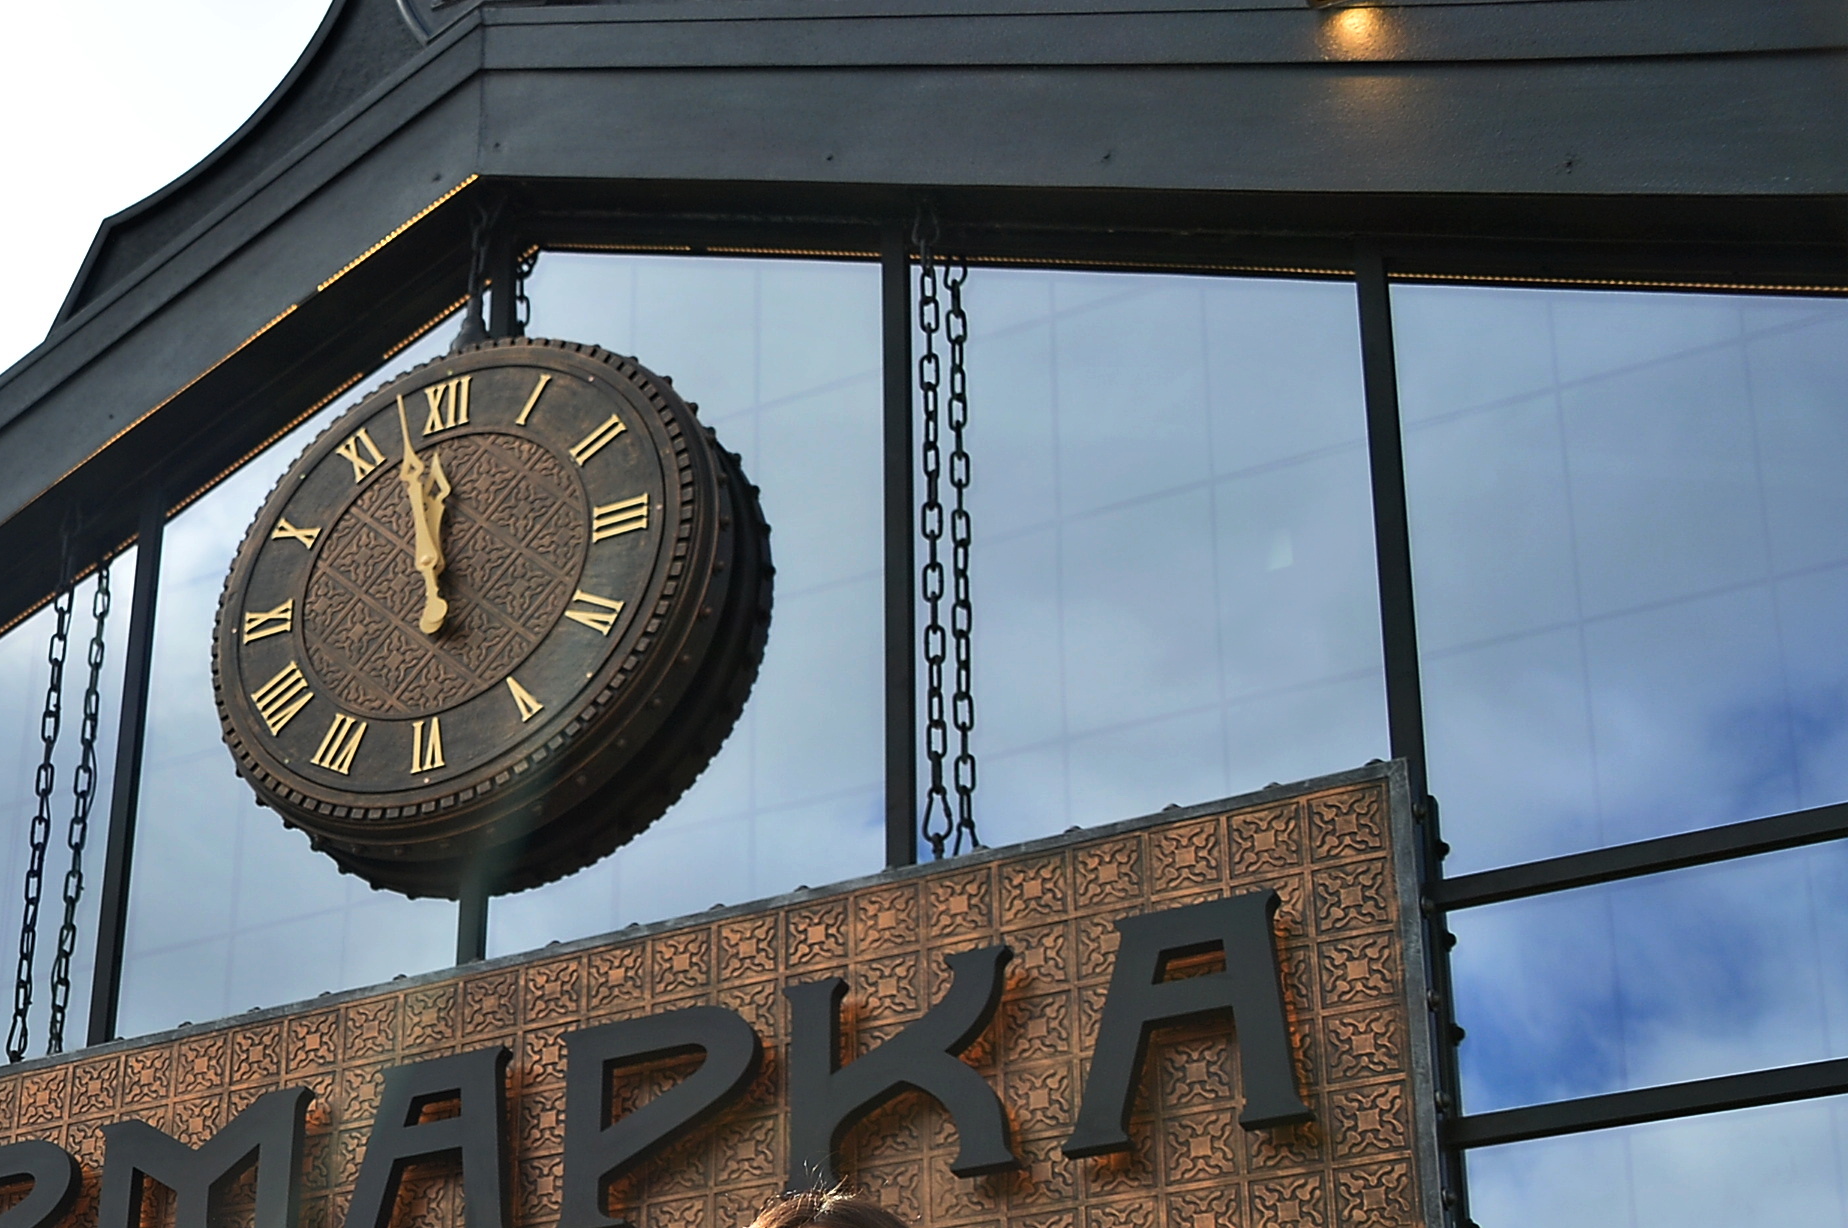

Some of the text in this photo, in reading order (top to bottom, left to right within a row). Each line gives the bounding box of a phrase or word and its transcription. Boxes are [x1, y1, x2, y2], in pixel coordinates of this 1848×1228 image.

[422, 375, 473, 437] XII
[515, 374, 552, 426] I
[335, 427, 386, 484] XI
[568, 413, 628, 466] II
[270, 517, 322, 550] X
[591, 492, 650, 544] III
[242, 598, 294, 644] IX
[564, 589, 626, 636] IV
[250, 660, 315, 737] VIII
[505, 676, 545, 723] V
[310, 712, 369, 776] VII
[410, 716, 446, 776] VI
